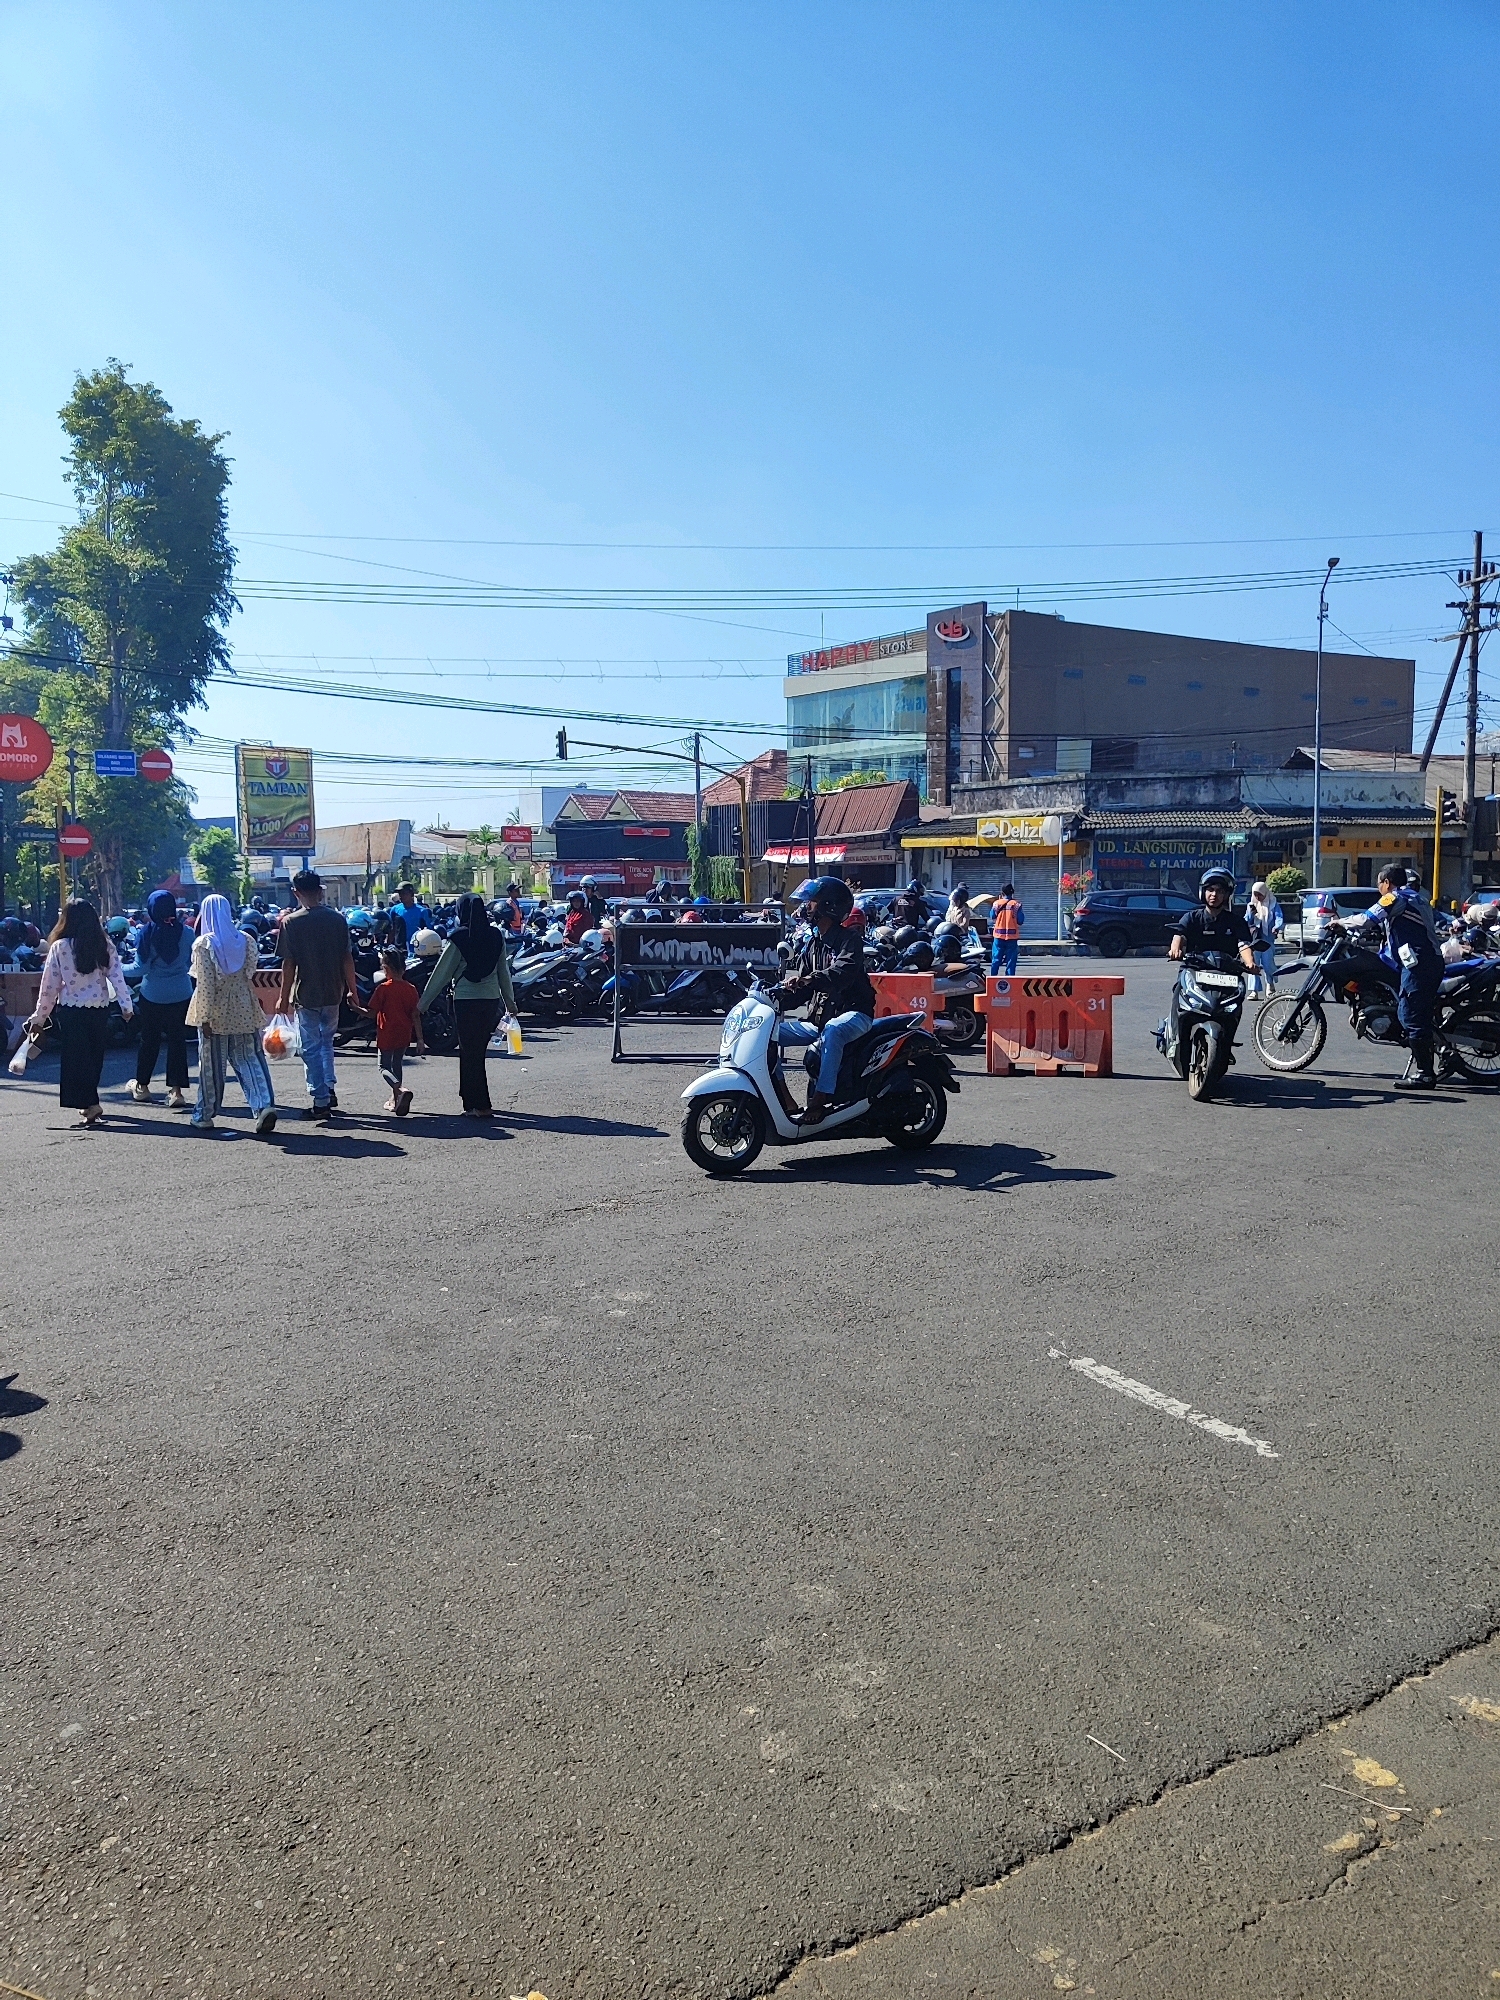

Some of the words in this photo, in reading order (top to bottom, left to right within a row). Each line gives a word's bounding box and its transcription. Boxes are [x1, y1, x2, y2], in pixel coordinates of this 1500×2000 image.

[801, 640, 873, 672] HAPPY
[879, 639, 914, 655] STORE
[247, 781, 309, 797] TAMPAN
[250, 820, 280, 836] 14.000
[298, 824, 308, 832] 20
[946, 848, 956, 858] D
[957, 848, 980, 857] Foto
[1097, 841, 1119, 853] UD.
[1123, 842, 1196, 854] LANGSUNG
[1198, 842, 1229, 857] JADI
[1098, 858, 1145, 868] STEMPEL
[1148, 859, 1157, 868] &
[1160, 859, 1187, 869] PLAT
[1189, 859, 1229, 869] NOMOR
[909, 996, 928, 1009] 49
[1087, 998, 1105, 1011] 31
